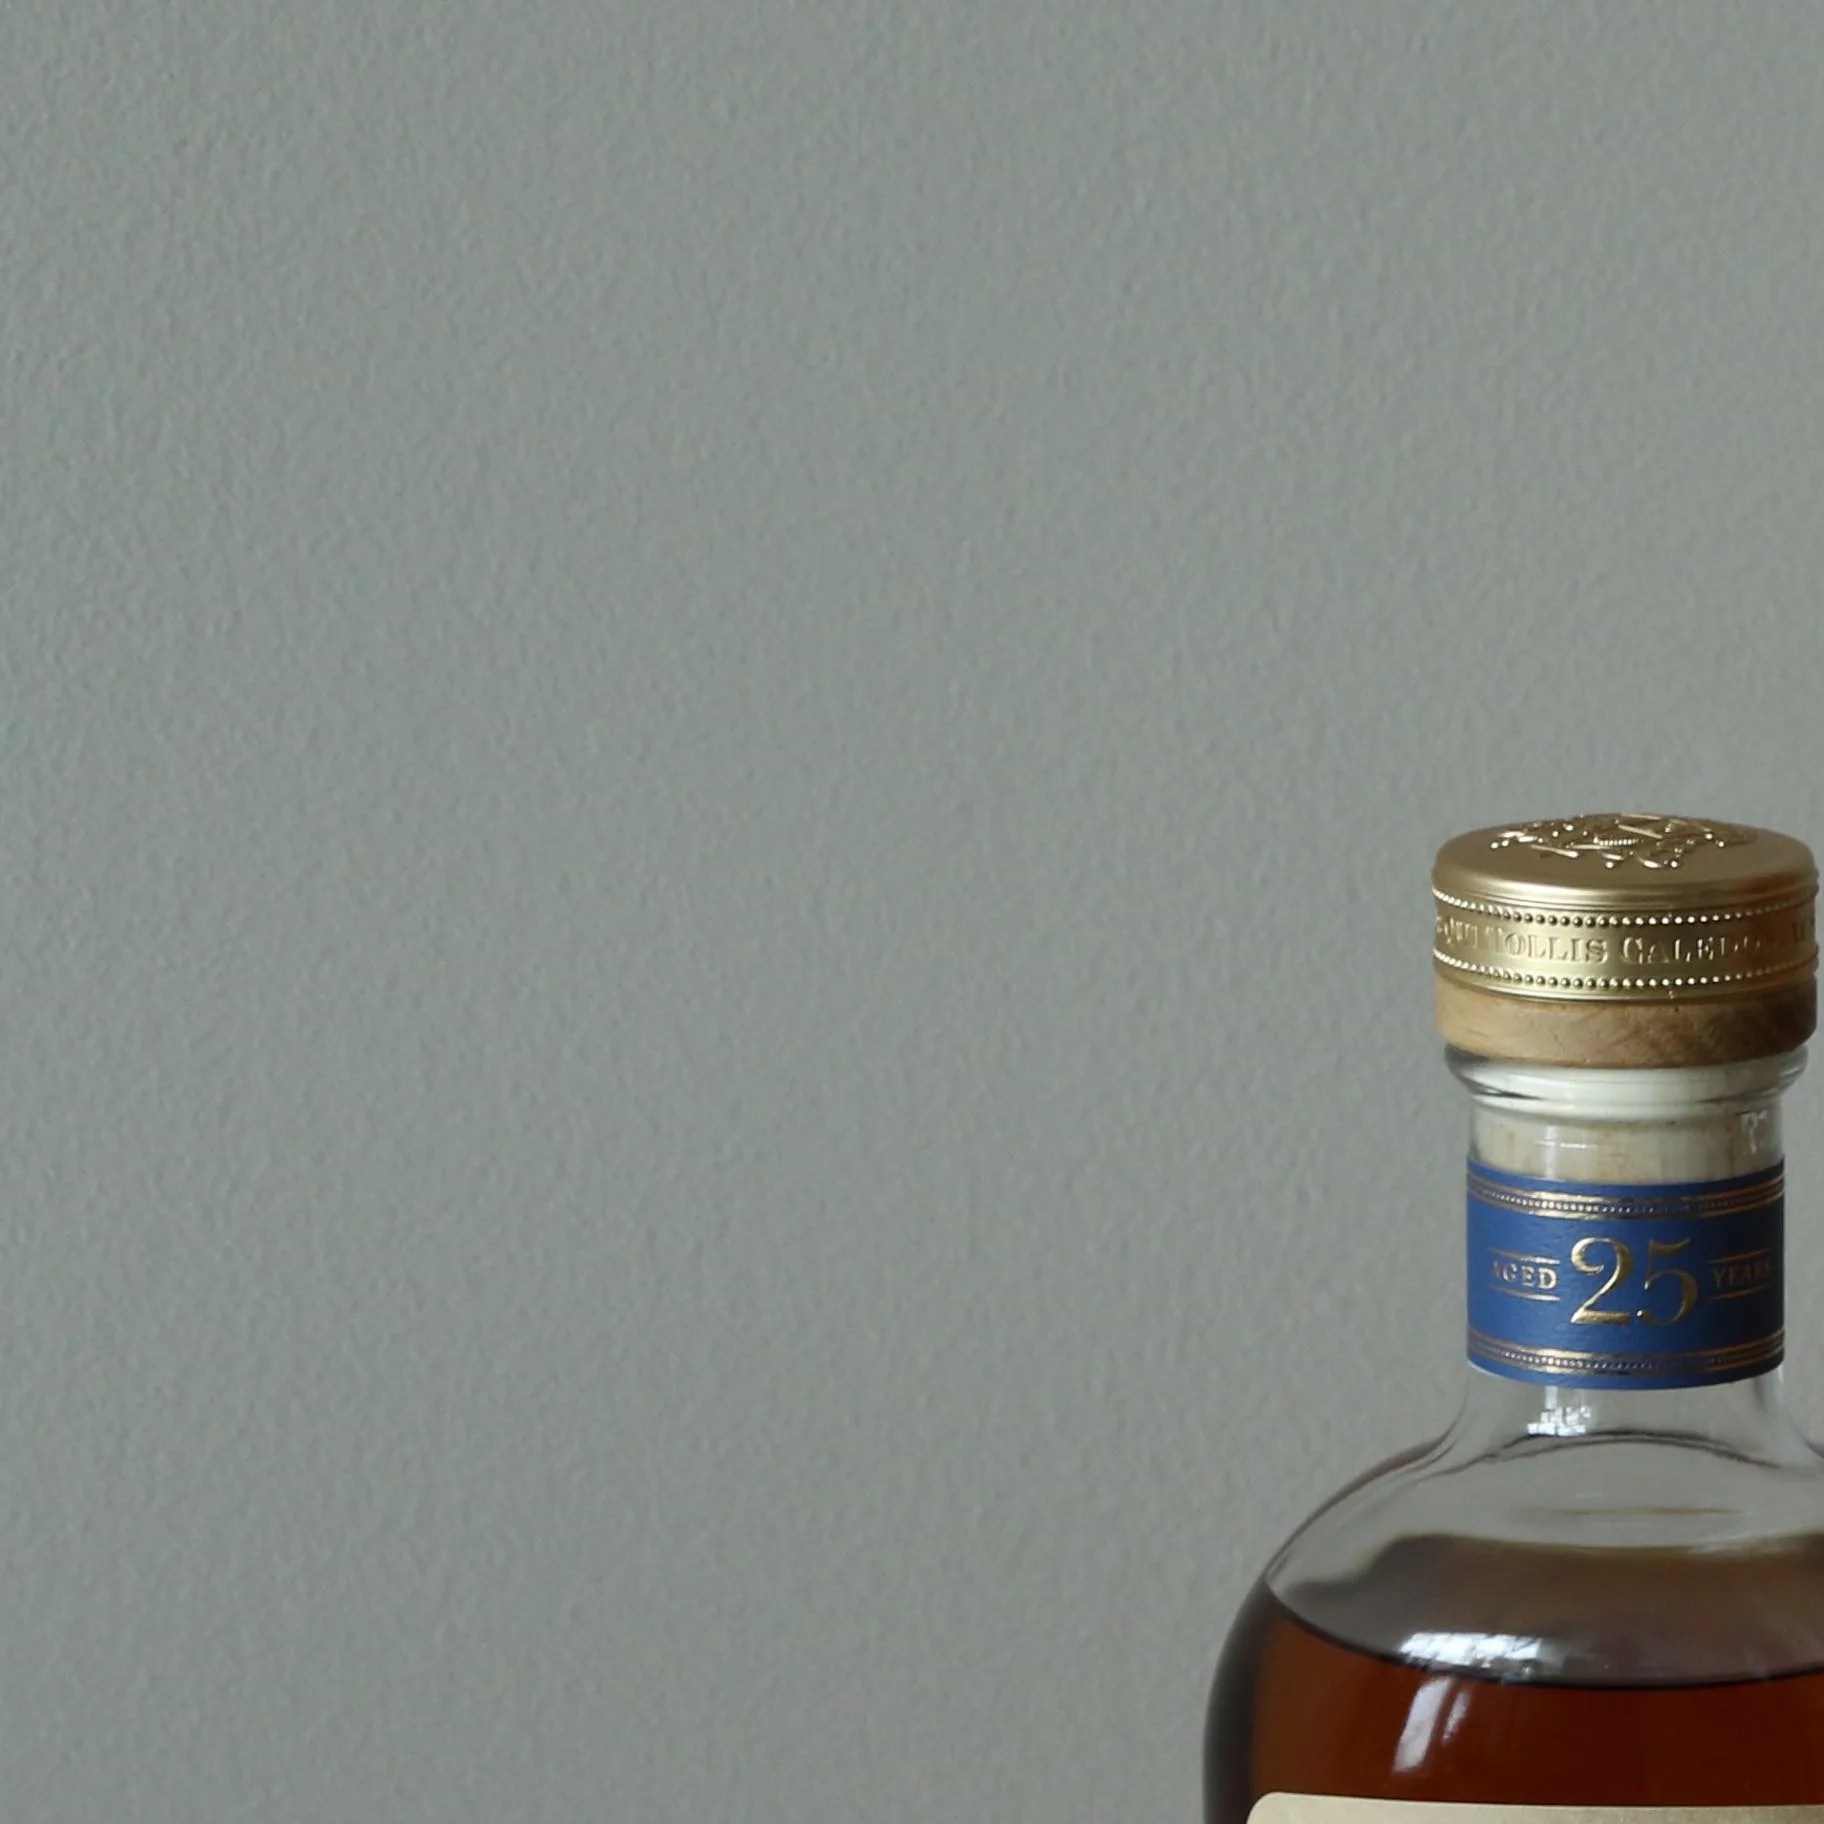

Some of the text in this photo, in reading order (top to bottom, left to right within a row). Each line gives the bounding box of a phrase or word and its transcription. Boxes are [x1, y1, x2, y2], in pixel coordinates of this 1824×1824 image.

[1484, 925, 1609, 965] TOLLIS
[1493, 1236, 1771, 1327] AGED 25 YEARS
